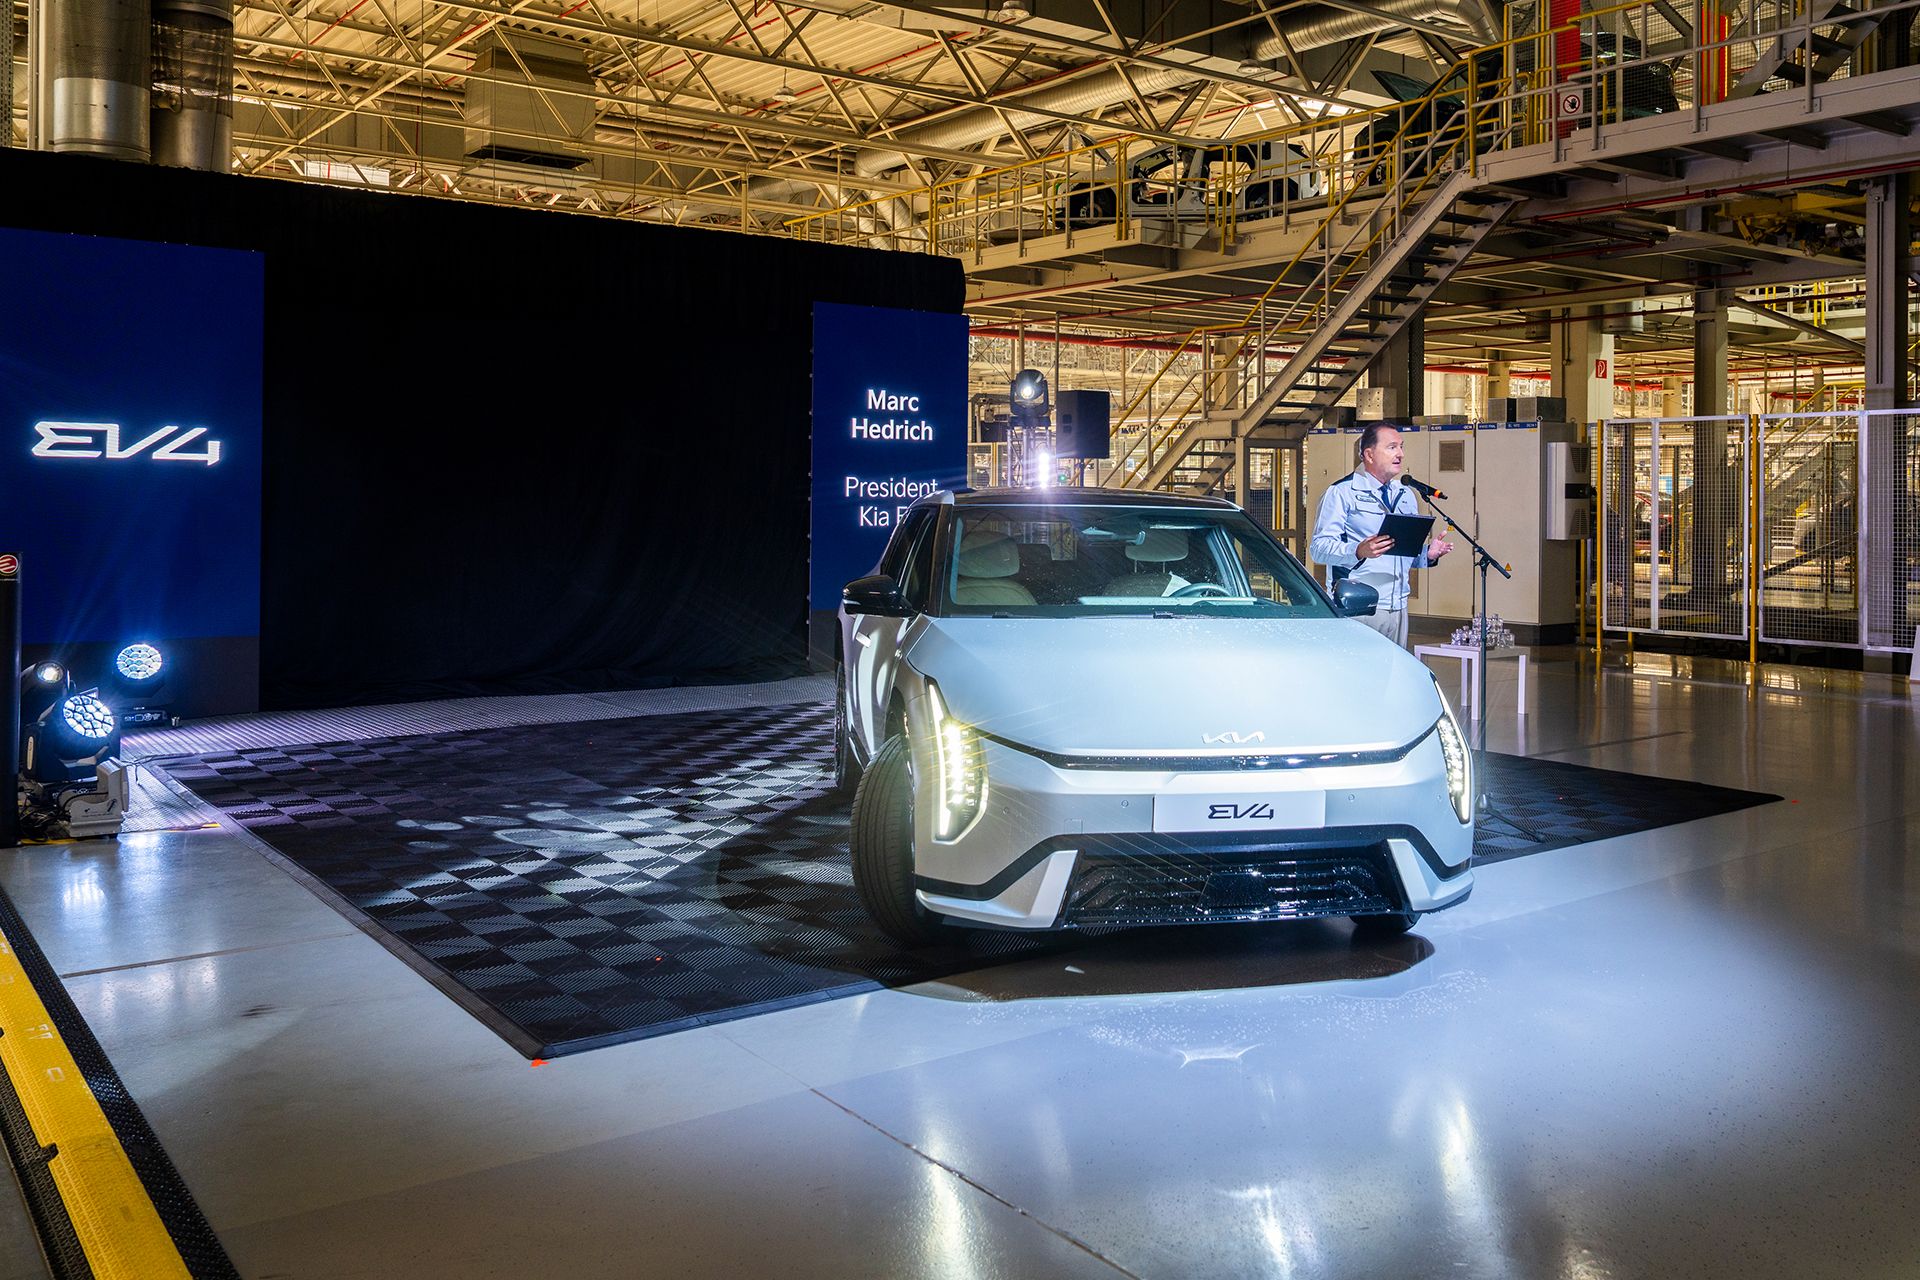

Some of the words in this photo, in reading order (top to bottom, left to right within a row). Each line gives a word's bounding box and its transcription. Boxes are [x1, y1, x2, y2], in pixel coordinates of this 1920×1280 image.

[867, 389, 919, 412] Marc
[851, 418, 933, 440] Hedrich
[32, 421, 220, 466] EV4
[845, 476, 938, 498] President
[860, 506, 890, 526] Kia
[1202, 731, 1265, 744] KIA
[1208, 803, 1274, 820] EV4
